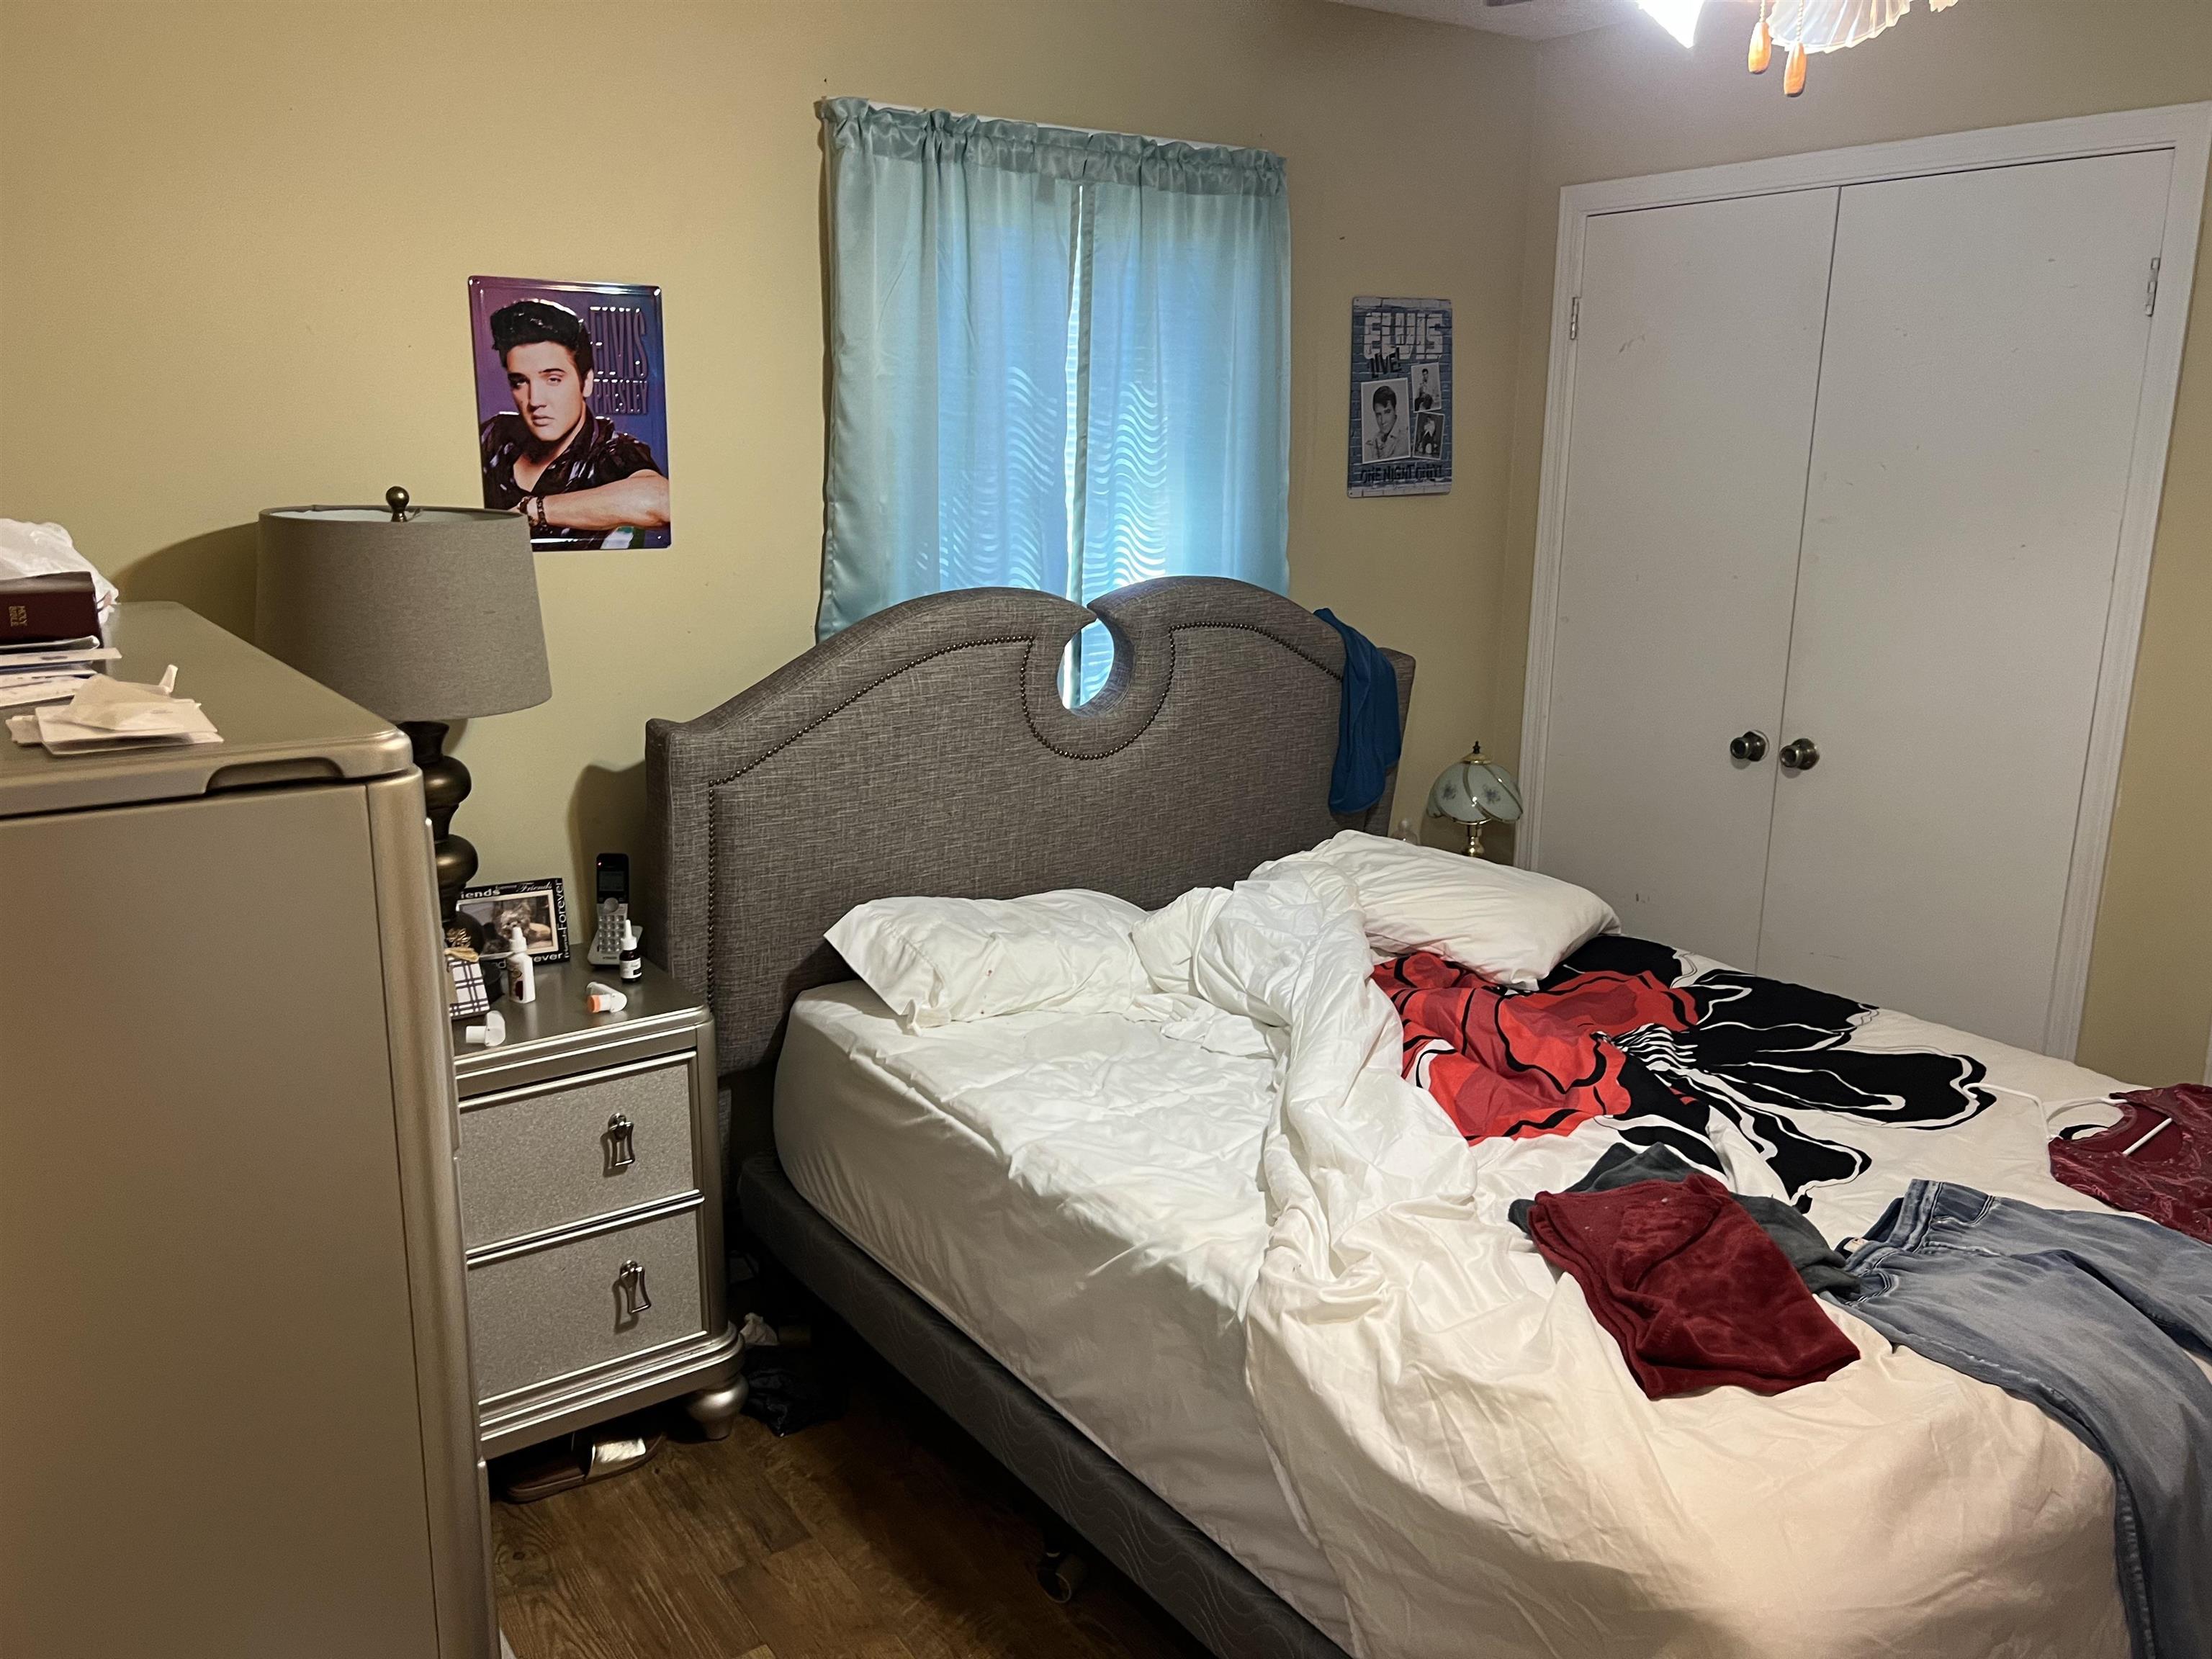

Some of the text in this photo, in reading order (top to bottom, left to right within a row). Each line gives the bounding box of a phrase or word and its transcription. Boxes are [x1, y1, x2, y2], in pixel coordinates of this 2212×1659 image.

[590, 306, 647, 378] ELVIS
[1364, 312, 1443, 360] ELVIS
[593, 379, 647, 414] PRESLEY
[1360, 467, 1382, 483] ONE
[1382, 464, 1415, 482] NIGHT
[460, 889, 501, 899] iends
[555, 878, 567, 930] Forever
